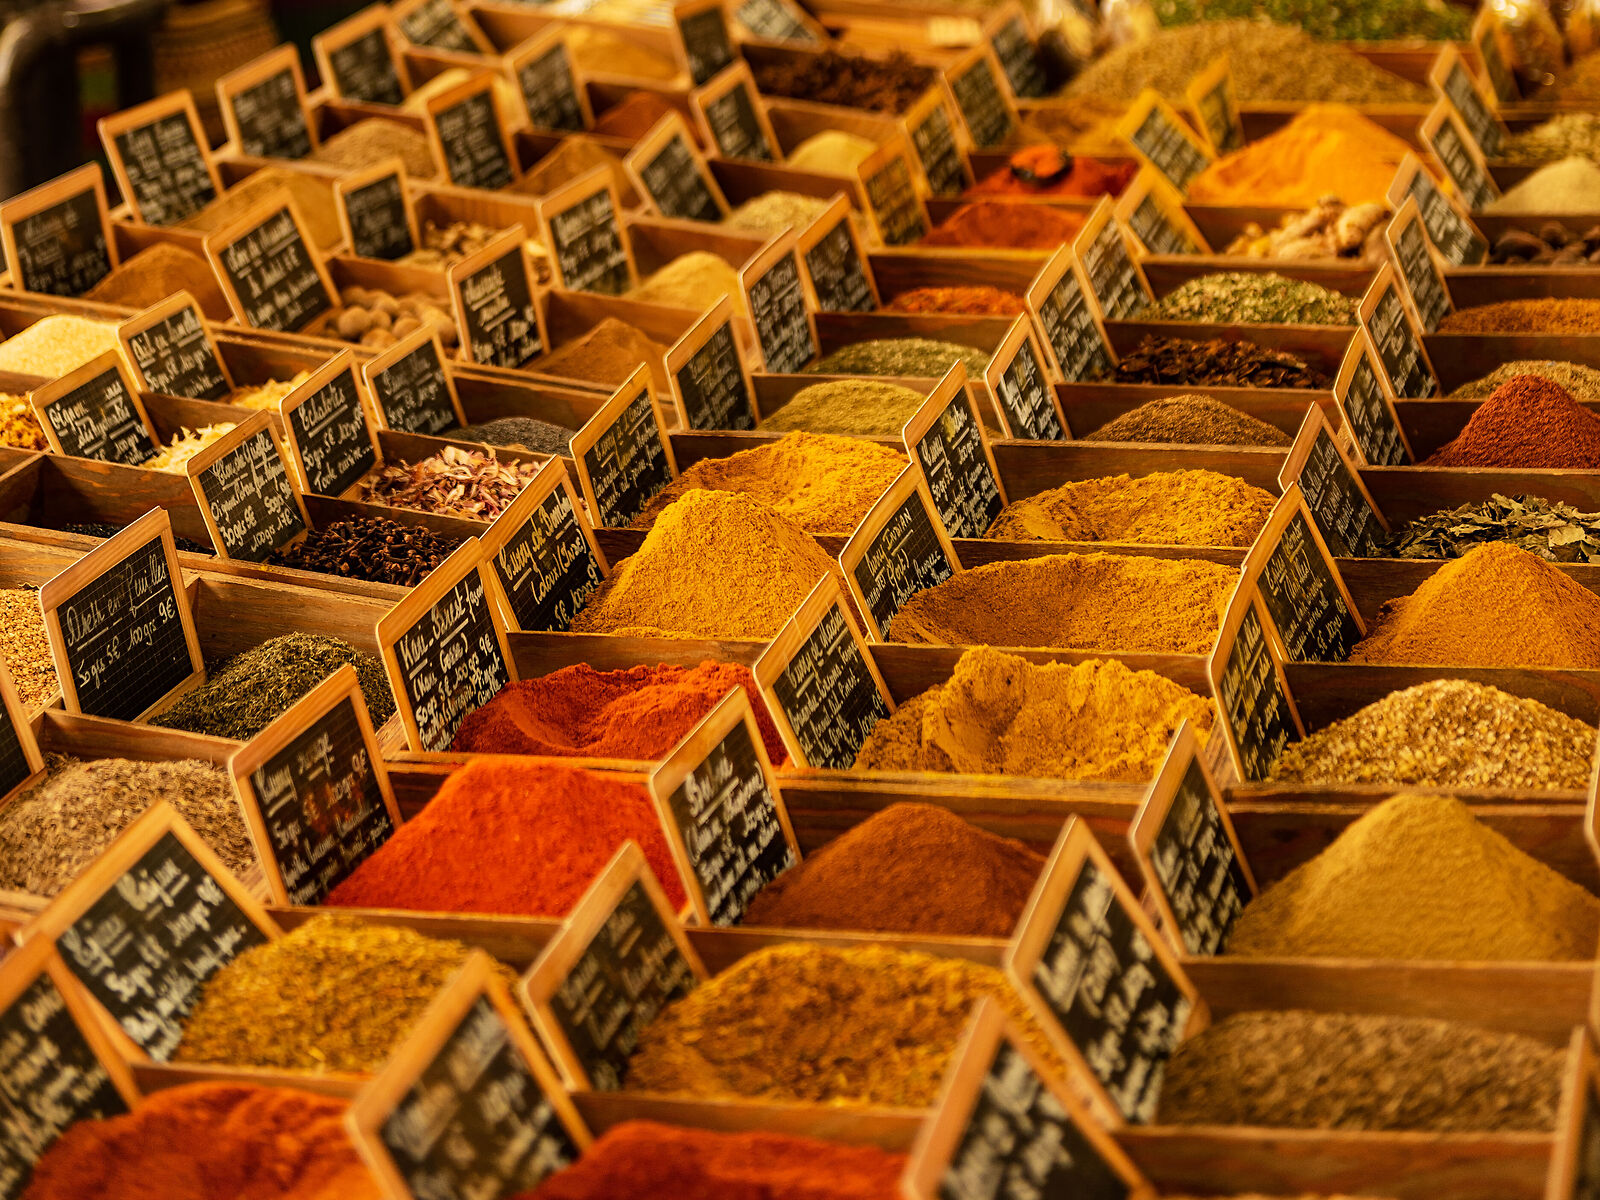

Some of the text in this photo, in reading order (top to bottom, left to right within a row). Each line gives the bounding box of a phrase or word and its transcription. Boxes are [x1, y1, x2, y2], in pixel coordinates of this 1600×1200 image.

[324, 428, 336, 453] 5€
[499, 490, 579, 582] Curry de Bombay
[107, 595, 121, 616] en
[125, 554, 167, 618] feuilles
[587, 551, 600, 586] 9€
[106, 636, 122, 664] 5€
[159, 596, 176, 624] 9€
[438, 676, 452, 701] 5€
[479, 634, 493, 656] 9€
[787, 651, 821, 688] Curry
[810, 637, 823, 661] de
